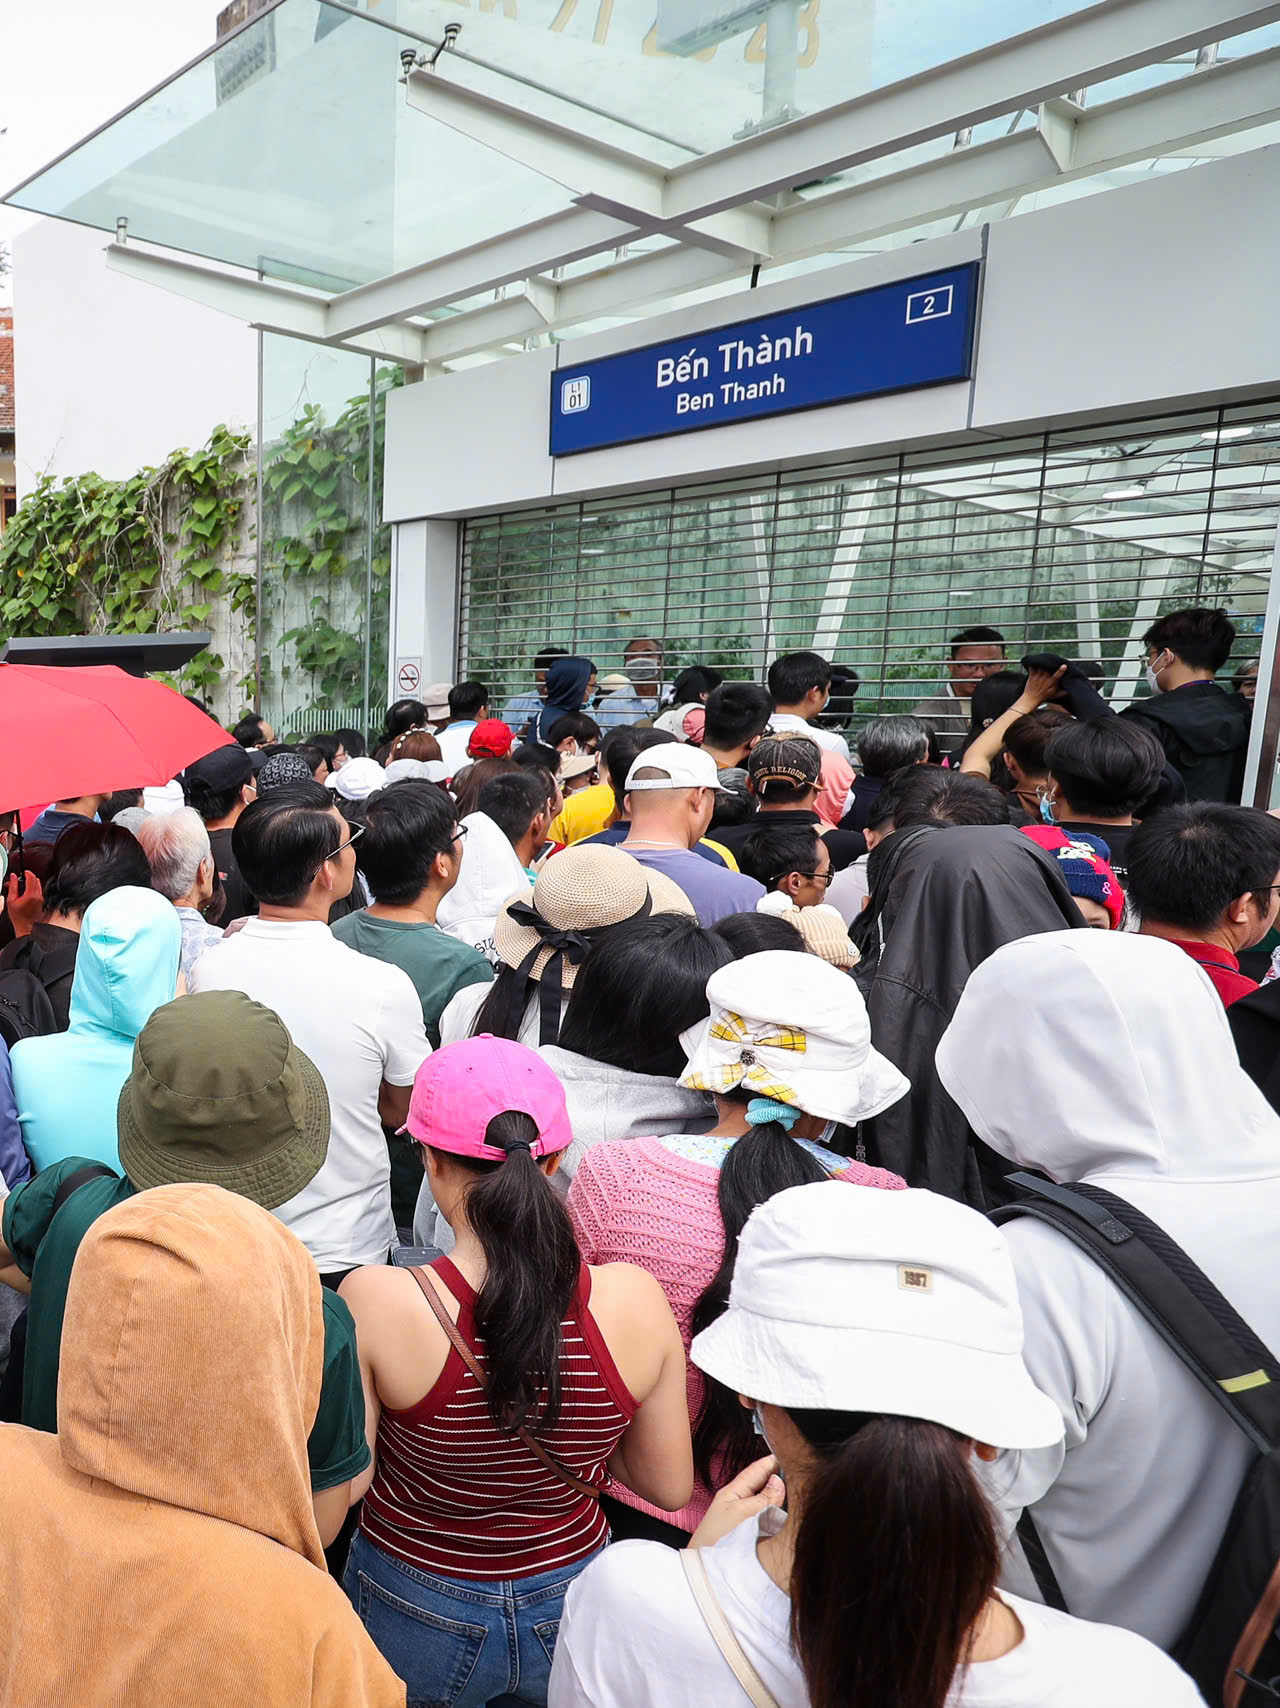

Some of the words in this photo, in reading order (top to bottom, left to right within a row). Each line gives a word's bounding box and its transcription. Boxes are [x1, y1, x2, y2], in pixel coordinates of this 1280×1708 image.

[923, 296, 935, 315] 2
[657, 349, 709, 388] Bến
[719, 326, 813, 373] Thành
[571, 382, 581, 393] L1
[676, 393, 714, 414] Ben
[721, 373, 785, 405] Thanh
[569, 394, 582, 408] 01
[754, 767, 769, 779] TRUE
[771, 766, 807, 781] RELIGION
